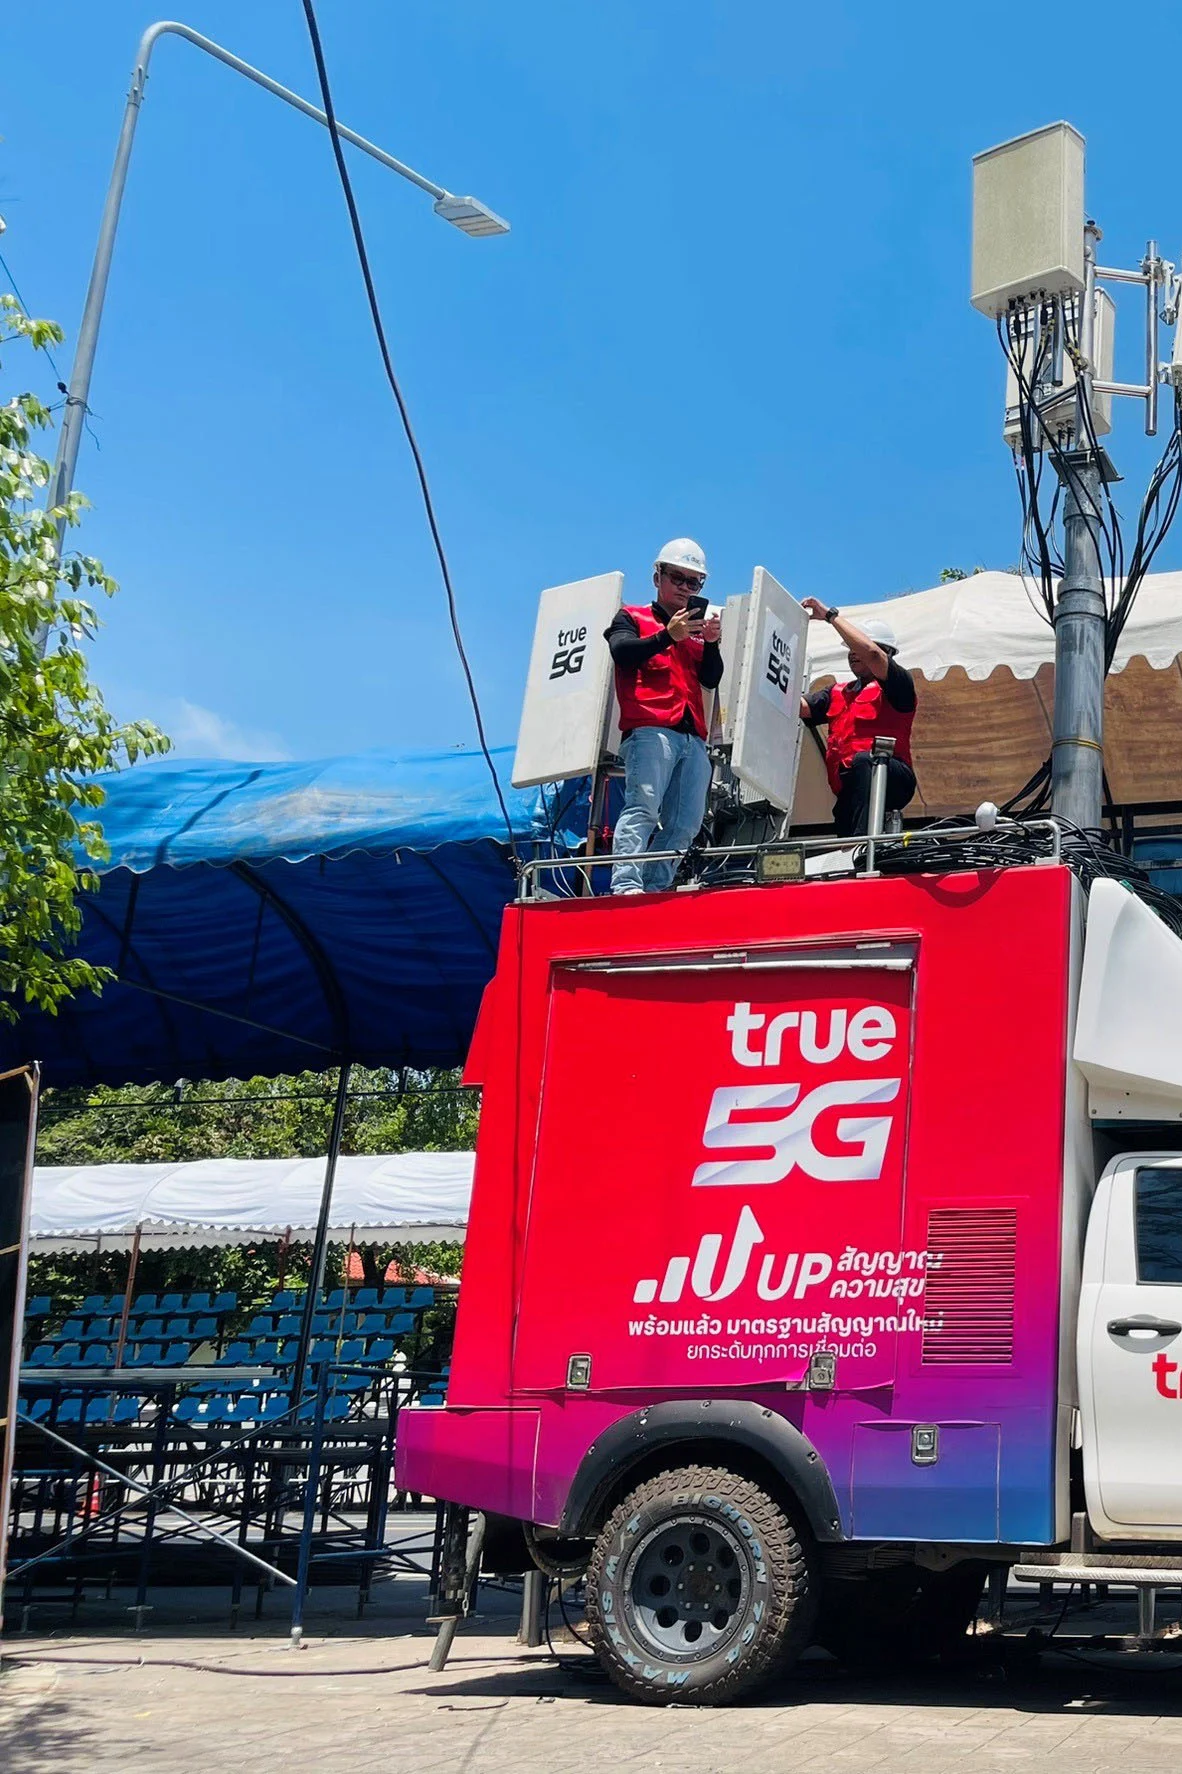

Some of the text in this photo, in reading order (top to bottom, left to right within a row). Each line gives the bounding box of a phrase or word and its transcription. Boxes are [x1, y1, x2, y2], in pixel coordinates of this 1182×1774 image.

[558, 626, 587, 647] true
[772, 630, 792, 662] true
[549, 645, 587, 680] 5G
[766, 652, 791, 694] 5G
[727, 1001, 897, 1067] true
[691, 1077, 902, 1187] 5G
[756, 1252, 833, 1300] UP
[829, 1277, 926, 1306] ความสุข
[628, 1313, 723, 1336] พร้อมแล้ว
[672, 1493, 768, 1585] BIGHORN
[602, 1591, 692, 1685] MAXXIS
